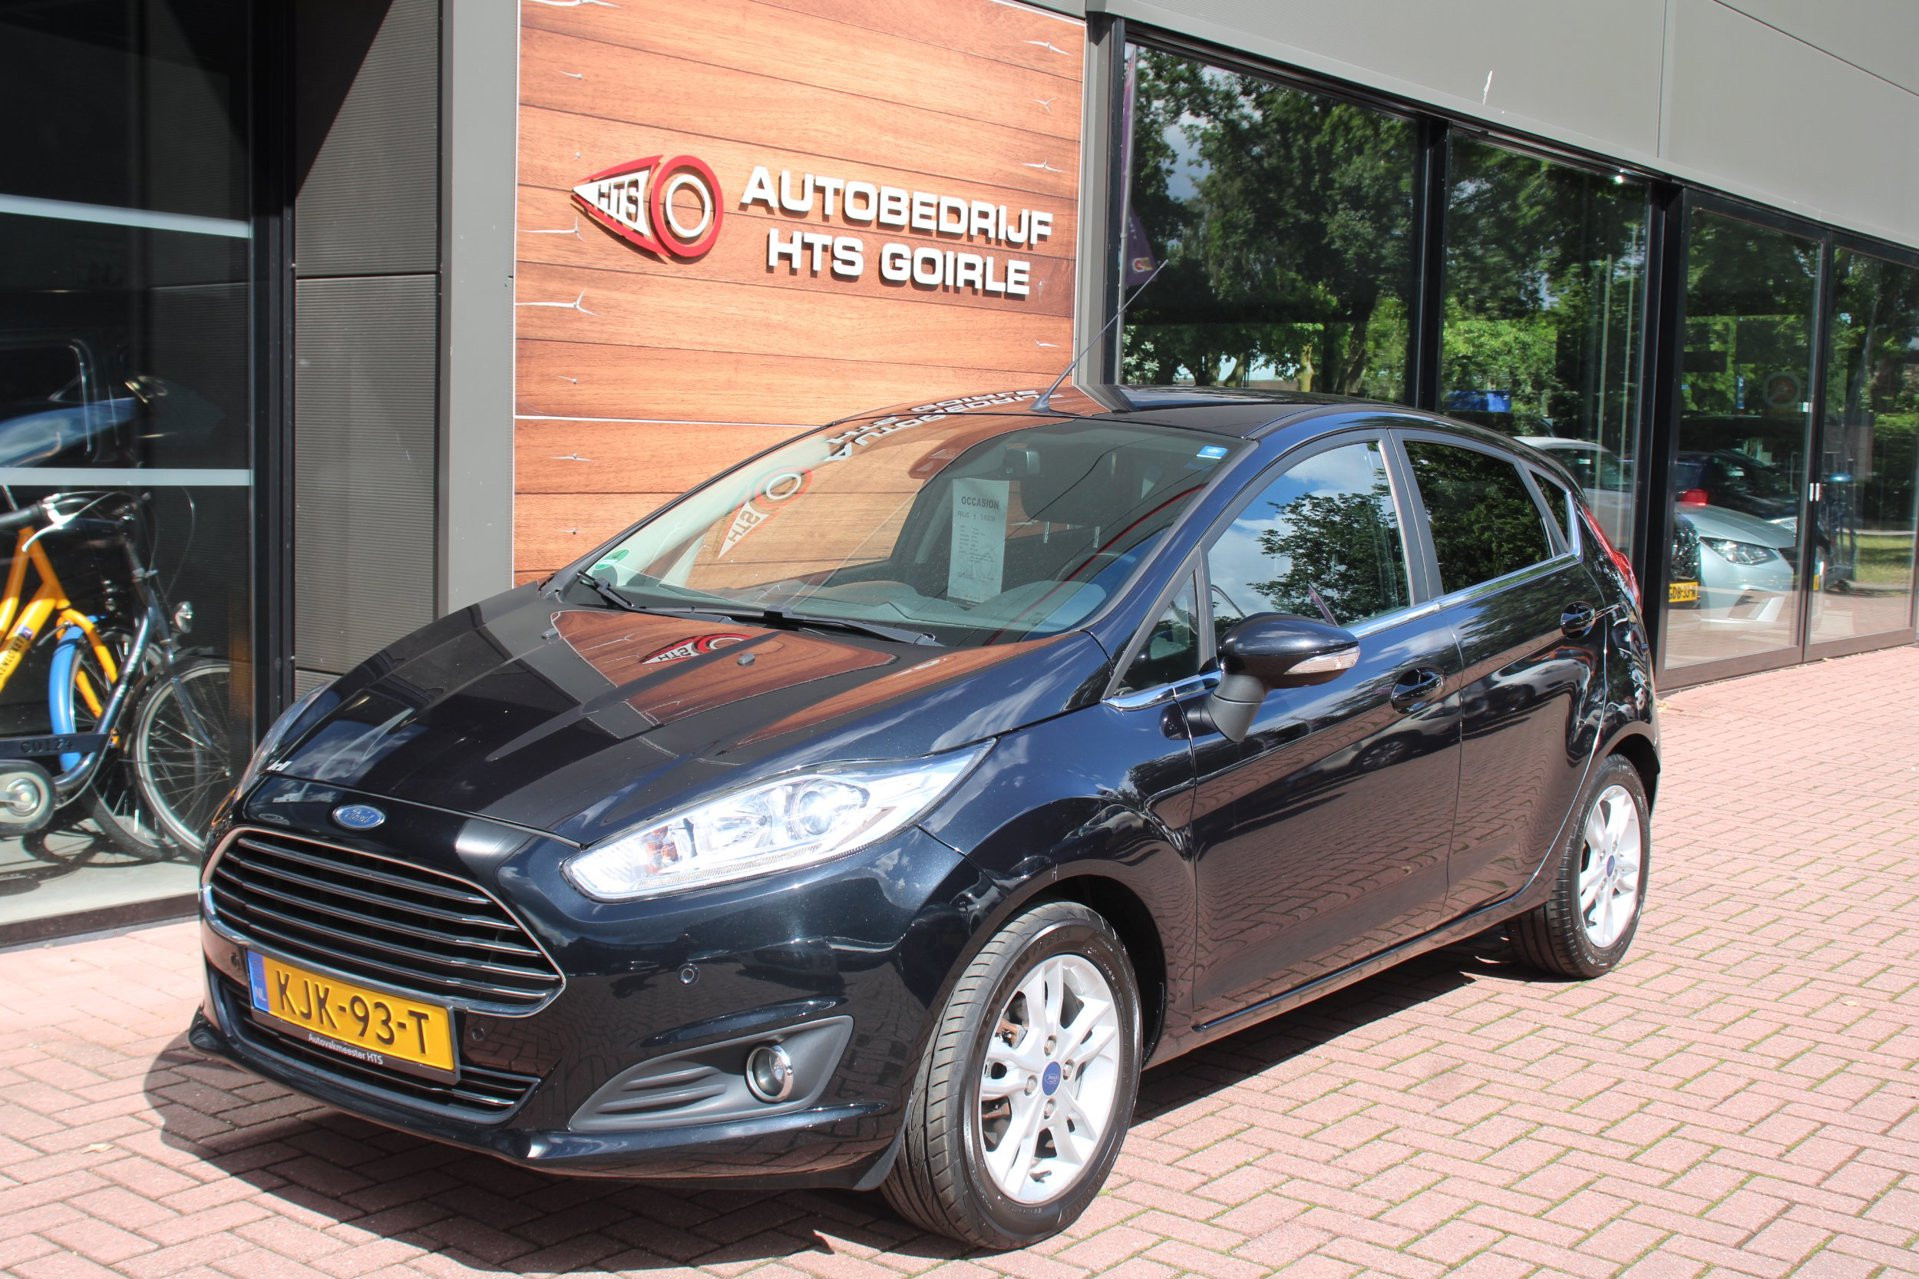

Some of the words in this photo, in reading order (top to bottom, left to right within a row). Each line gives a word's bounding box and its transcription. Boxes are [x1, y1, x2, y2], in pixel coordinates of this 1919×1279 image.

[597, 178, 640, 223] HTS
[740, 165, 1054, 246] AUTOBEDRIJF
[767, 227, 864, 277] HTS
[881, 242, 1031, 296] GOIRLE
[961, 496, 999, 510] OCCASION
[276, 969, 431, 1055] KJK-93-T
[366, 1051, 384, 1066] HTS
